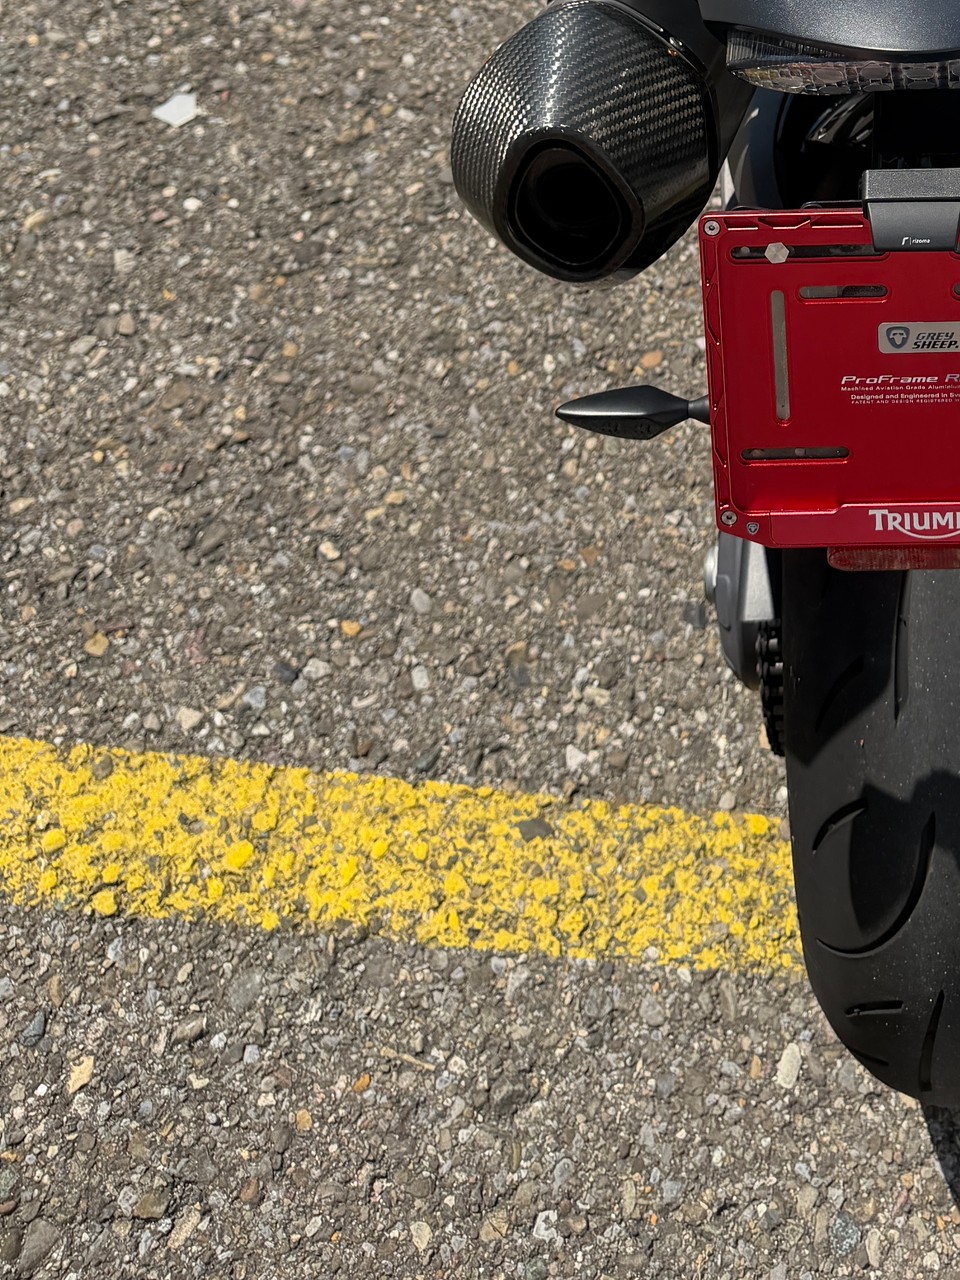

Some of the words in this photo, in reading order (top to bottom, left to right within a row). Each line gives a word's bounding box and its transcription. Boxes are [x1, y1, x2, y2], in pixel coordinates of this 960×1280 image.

[916, 331, 955, 340] GREY
[841, 374, 939, 384] ProFrame
[900, 392, 940, 400] Engineered
